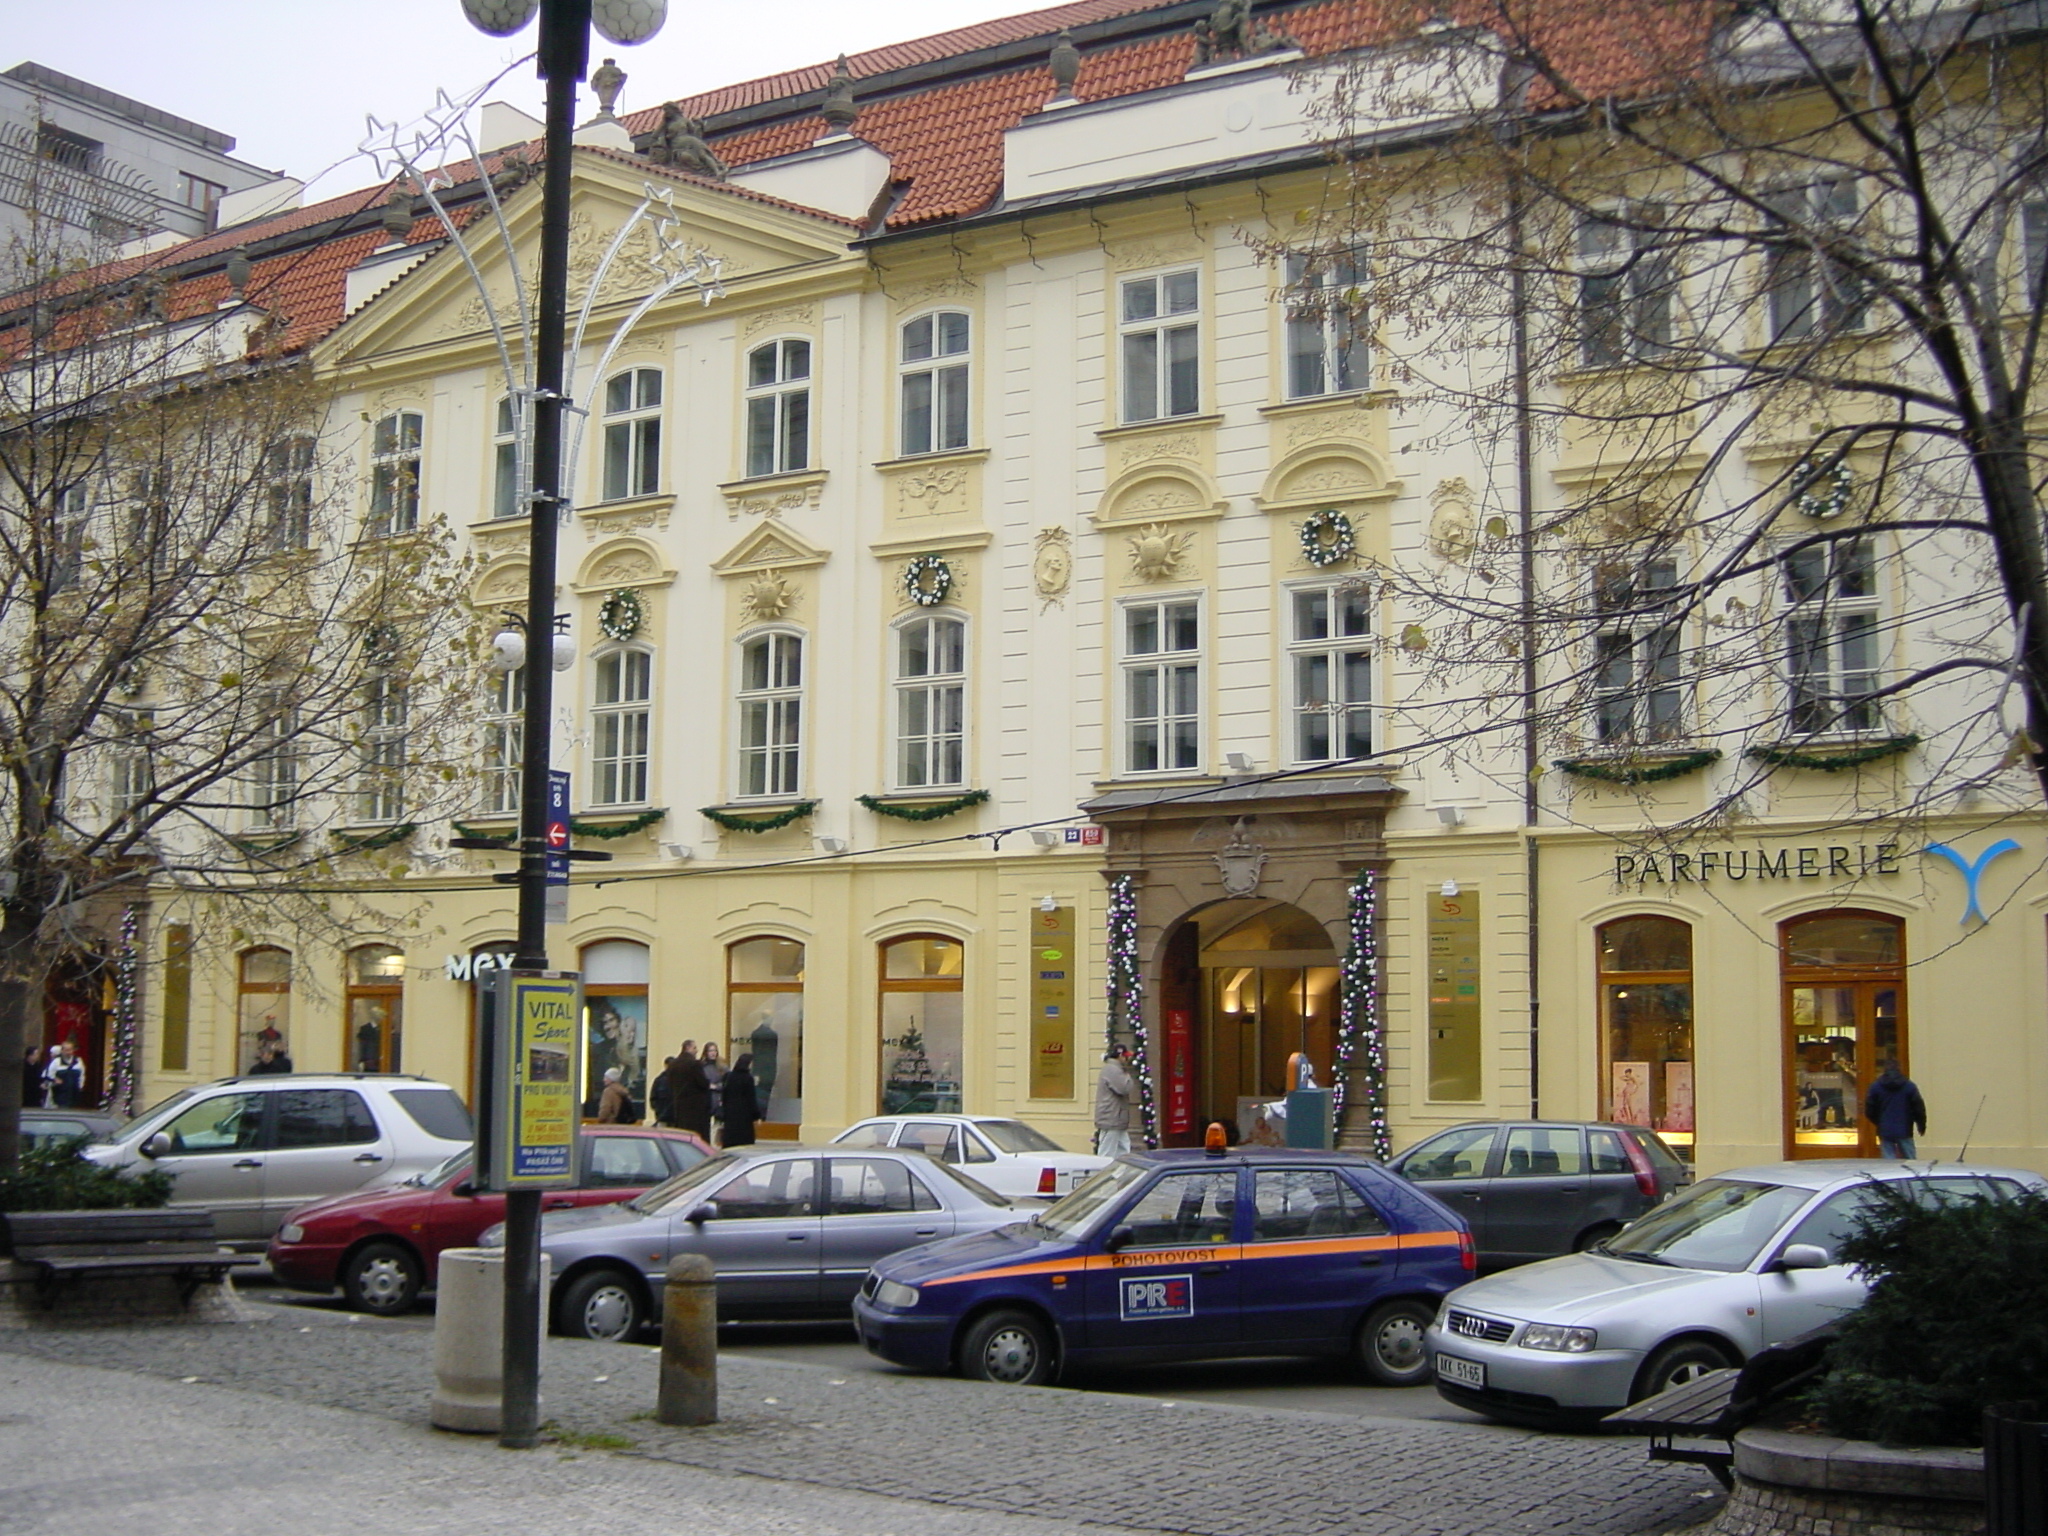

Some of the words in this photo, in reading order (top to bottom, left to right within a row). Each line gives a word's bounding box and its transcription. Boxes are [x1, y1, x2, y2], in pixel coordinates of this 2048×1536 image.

[553, 792, 562, 808] 8
[1614, 843, 1901, 884] PARFUMERIE
[529, 1001, 573, 1019] VITAL
[533, 1021, 570, 1042] Sport
[1301, 1063, 1308, 1082] P
[1111, 1248, 1217, 1267] POHOTOVOST
[1128, 1281, 1187, 1309] PRE
